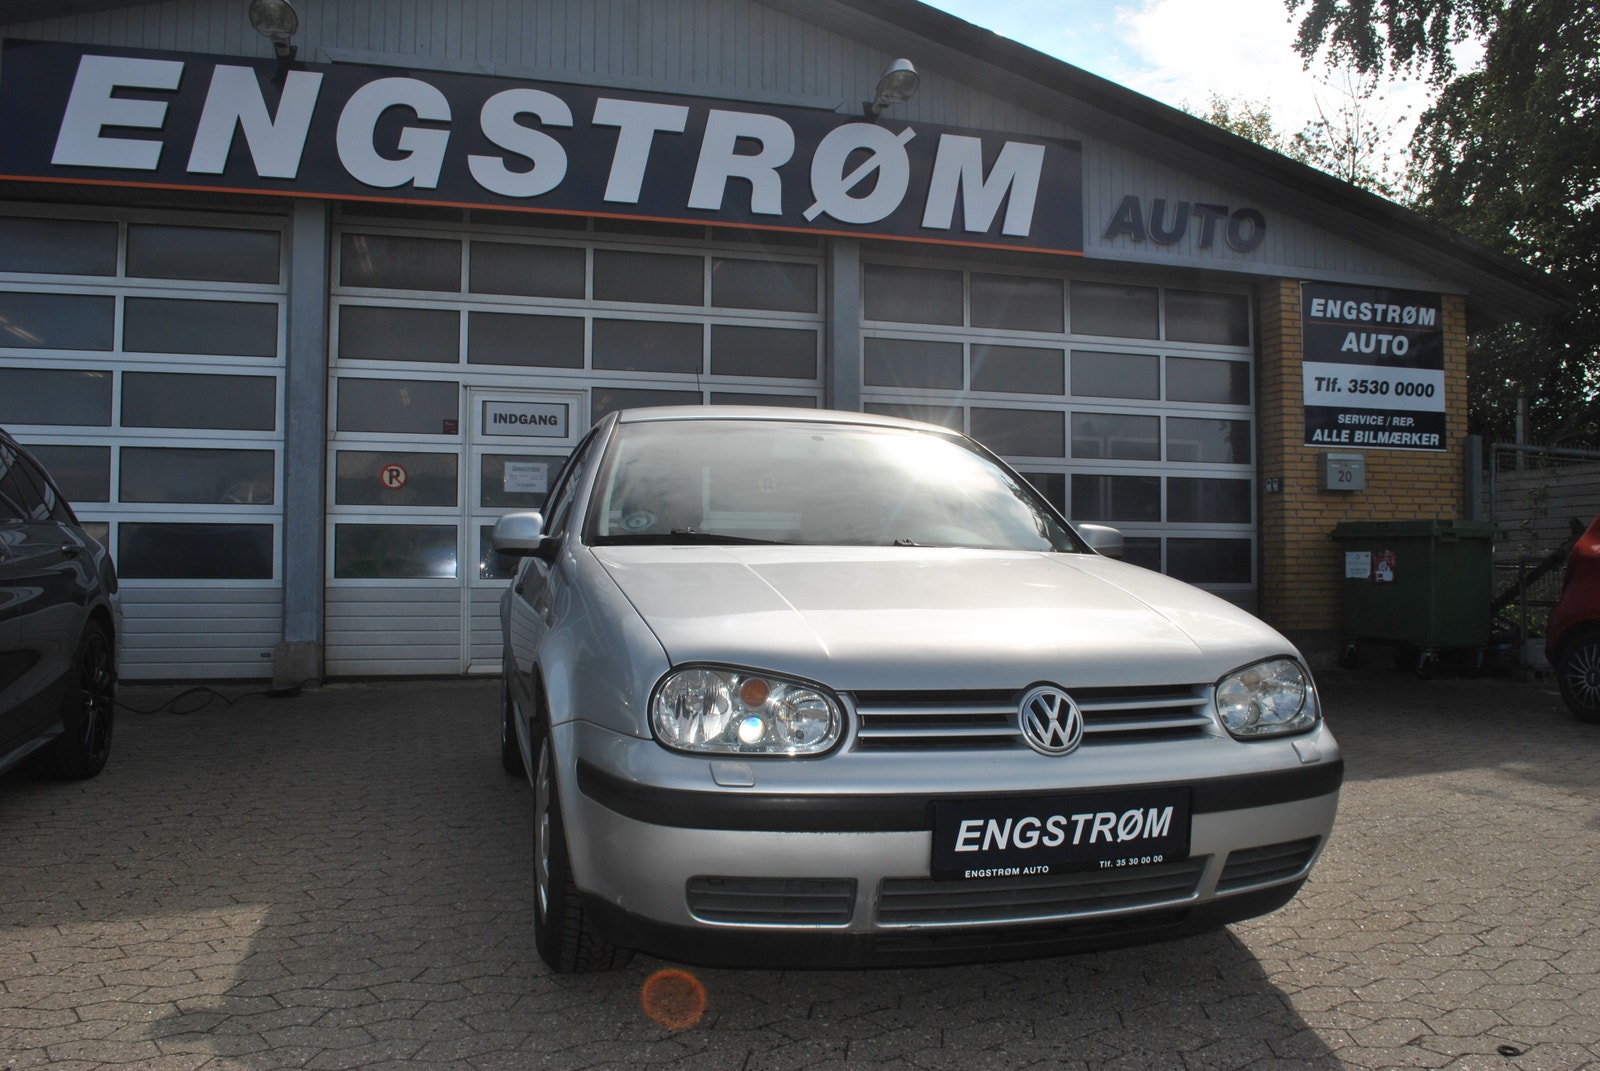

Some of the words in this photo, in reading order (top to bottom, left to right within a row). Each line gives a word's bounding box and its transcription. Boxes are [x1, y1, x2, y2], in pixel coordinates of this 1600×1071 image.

[51, 54, 1046, 237] ENGSTRØM
[1104, 194, 1267, 253] AUTO
[1310, 298, 1436, 326] ENGSTRØM
[1341, 331, 1409, 355] AUTO
[1314, 376, 1342, 392] Tlf.
[1347, 378, 1390, 395] 3530
[1394, 381, 1435, 398] 0000
[493, 412, 558, 426] INDGANG
[1337, 413, 1384, 426] SERVICE
[1392, 416, 1415, 427] REP.
[1312, 428, 1350, 443] ALLE
[1353, 430, 1440, 446] BILMÆRKER
[1337, 470, 1353, 483] 20
[954, 806, 1174, 852] ENGSTRØM
[1116, 858, 1126, 867] 35
[1128, 857, 1139, 865] 30
[1140, 856, 1151, 864] 00
[1153, 855, 1163, 863] 00
[964, 868, 1020, 879] ENGSTRØM
[1023, 865, 1050, 875] AUTO
